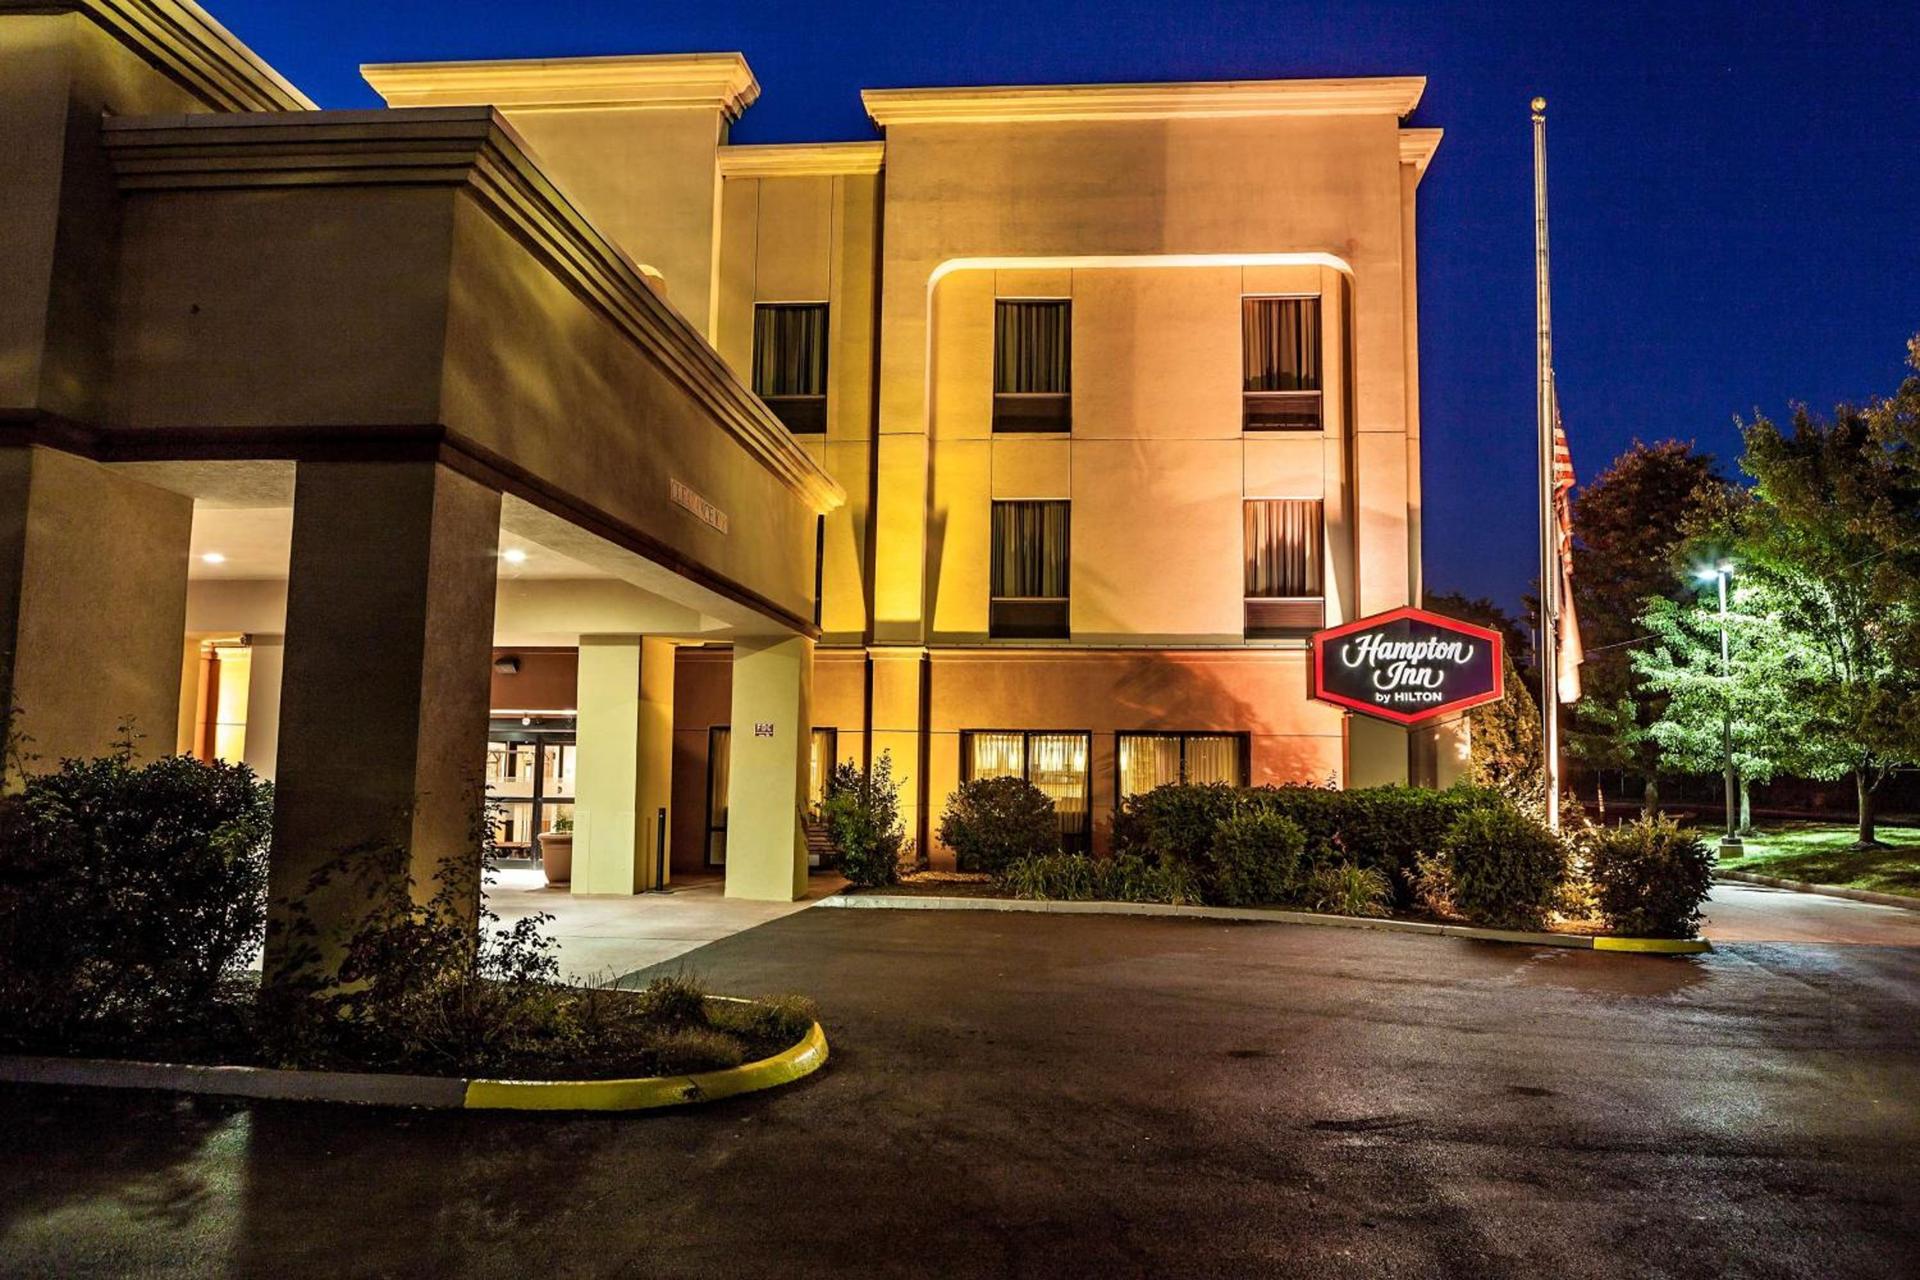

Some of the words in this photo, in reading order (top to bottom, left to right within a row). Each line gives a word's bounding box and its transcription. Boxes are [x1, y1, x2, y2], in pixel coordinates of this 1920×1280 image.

[1342, 633, 1474, 667] Hampton
[1373, 661, 1444, 690] Inn
[1375, 692, 1391, 704] by
[1395, 692, 1442, 702] HILTON
